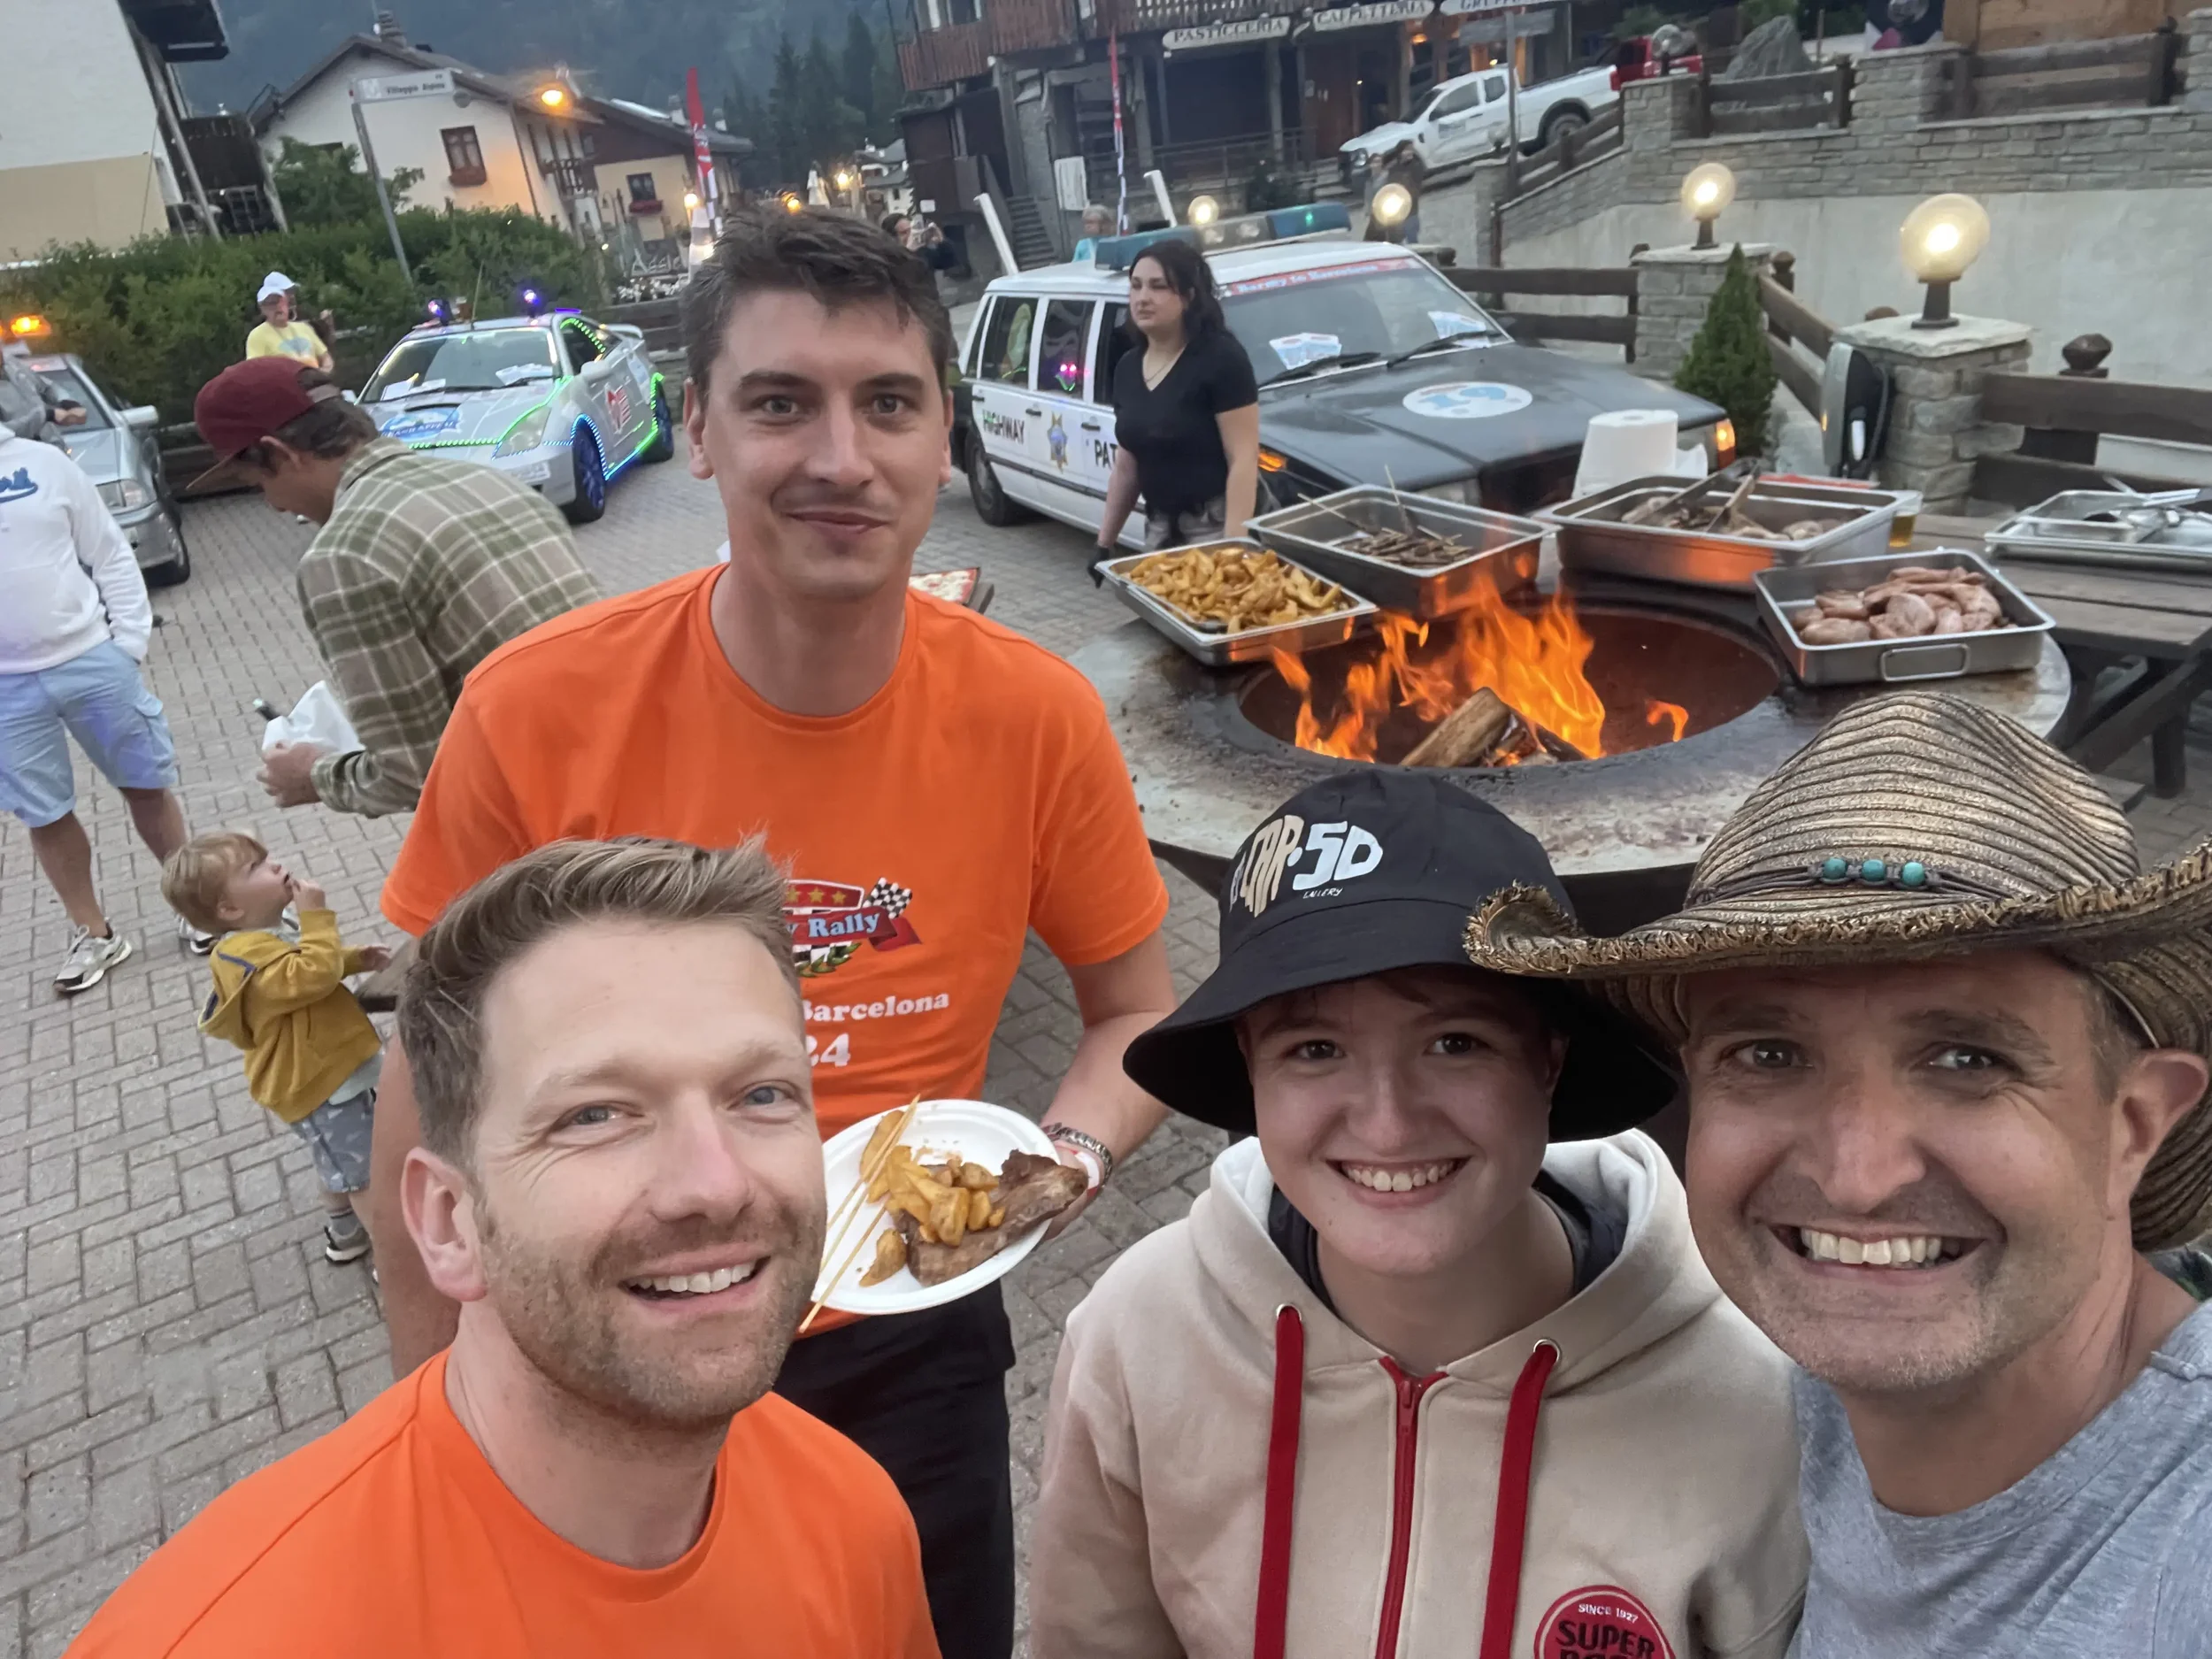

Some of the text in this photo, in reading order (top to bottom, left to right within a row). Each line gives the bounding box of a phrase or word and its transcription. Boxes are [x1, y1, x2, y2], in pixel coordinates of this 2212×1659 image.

[1173, 19, 1283, 43] PASTICCERIA
[982, 408, 1118, 469] HIGHWAY PAT
[808, 912, 880, 938] Rally
[803, 993, 950, 1022] Barcelona
[805, 1032, 852, 1067] 24
[1578, 1603, 1639, 1624] SINCE 1927
[1555, 1620, 1656, 1659] SUPER
